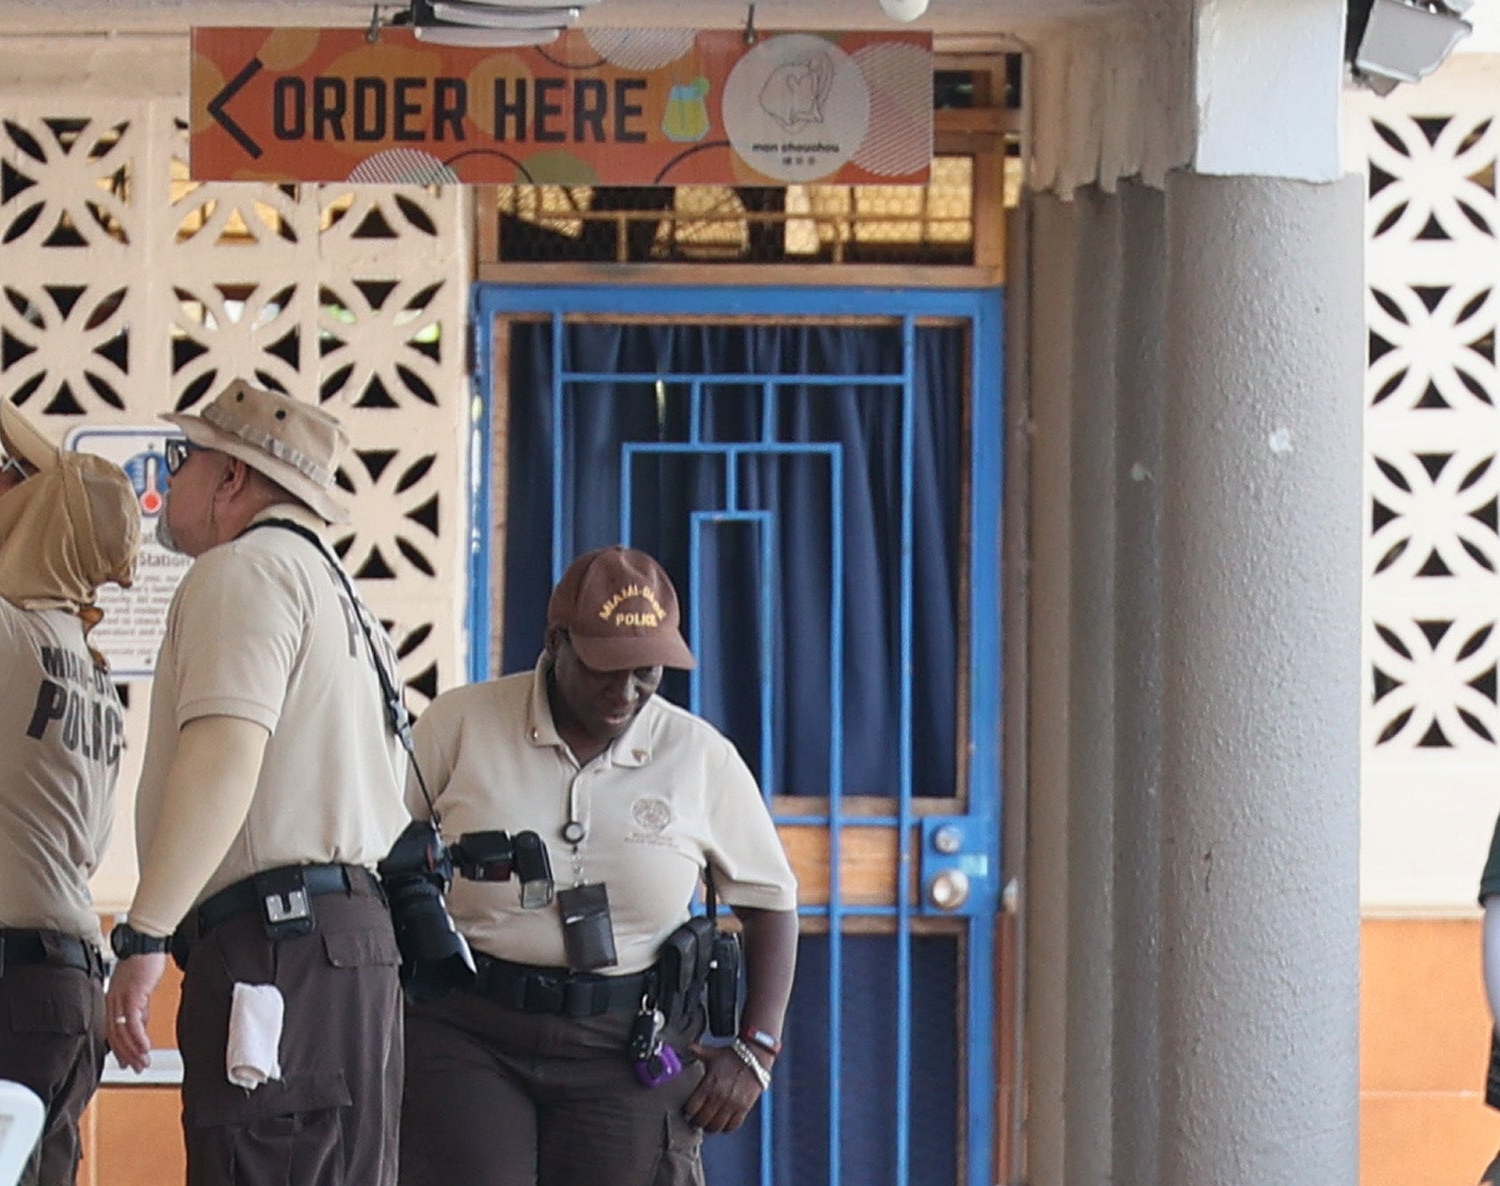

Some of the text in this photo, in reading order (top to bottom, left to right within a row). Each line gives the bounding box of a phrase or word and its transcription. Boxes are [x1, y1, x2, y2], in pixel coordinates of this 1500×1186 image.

[273, 76, 648, 143] ORDER HERE
[615, 612, 658, 627] POLICE
[26, 680, 124, 766] POLIC
